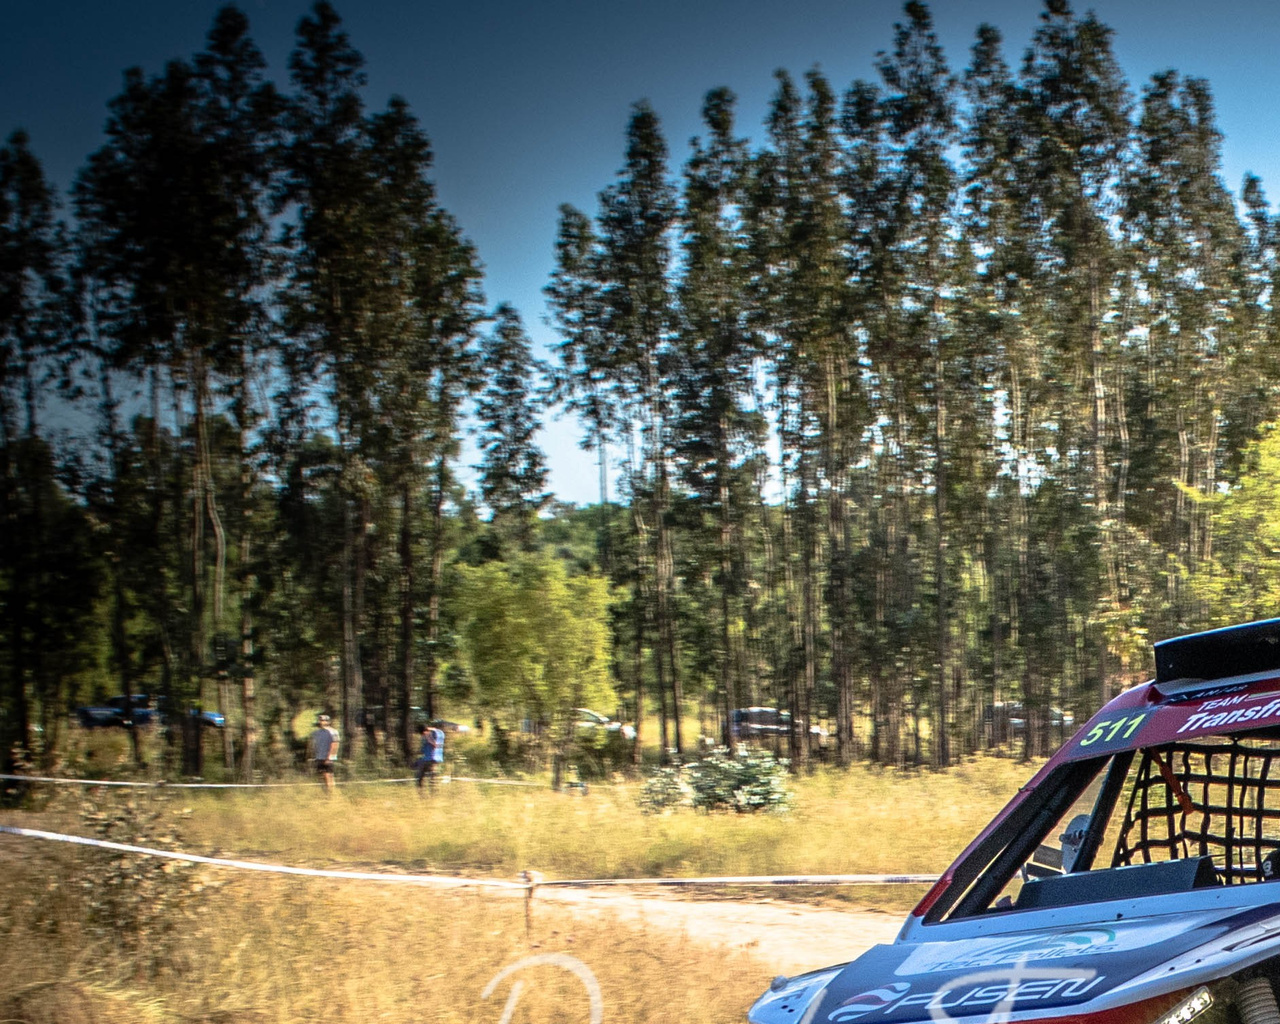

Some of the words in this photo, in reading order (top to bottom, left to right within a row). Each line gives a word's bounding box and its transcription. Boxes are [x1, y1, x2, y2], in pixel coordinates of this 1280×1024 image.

[1197, 694, 1249, 711] TEAM
[1080, 713, 1147, 746] 511
[884, 976, 1106, 1014] FUSEN
